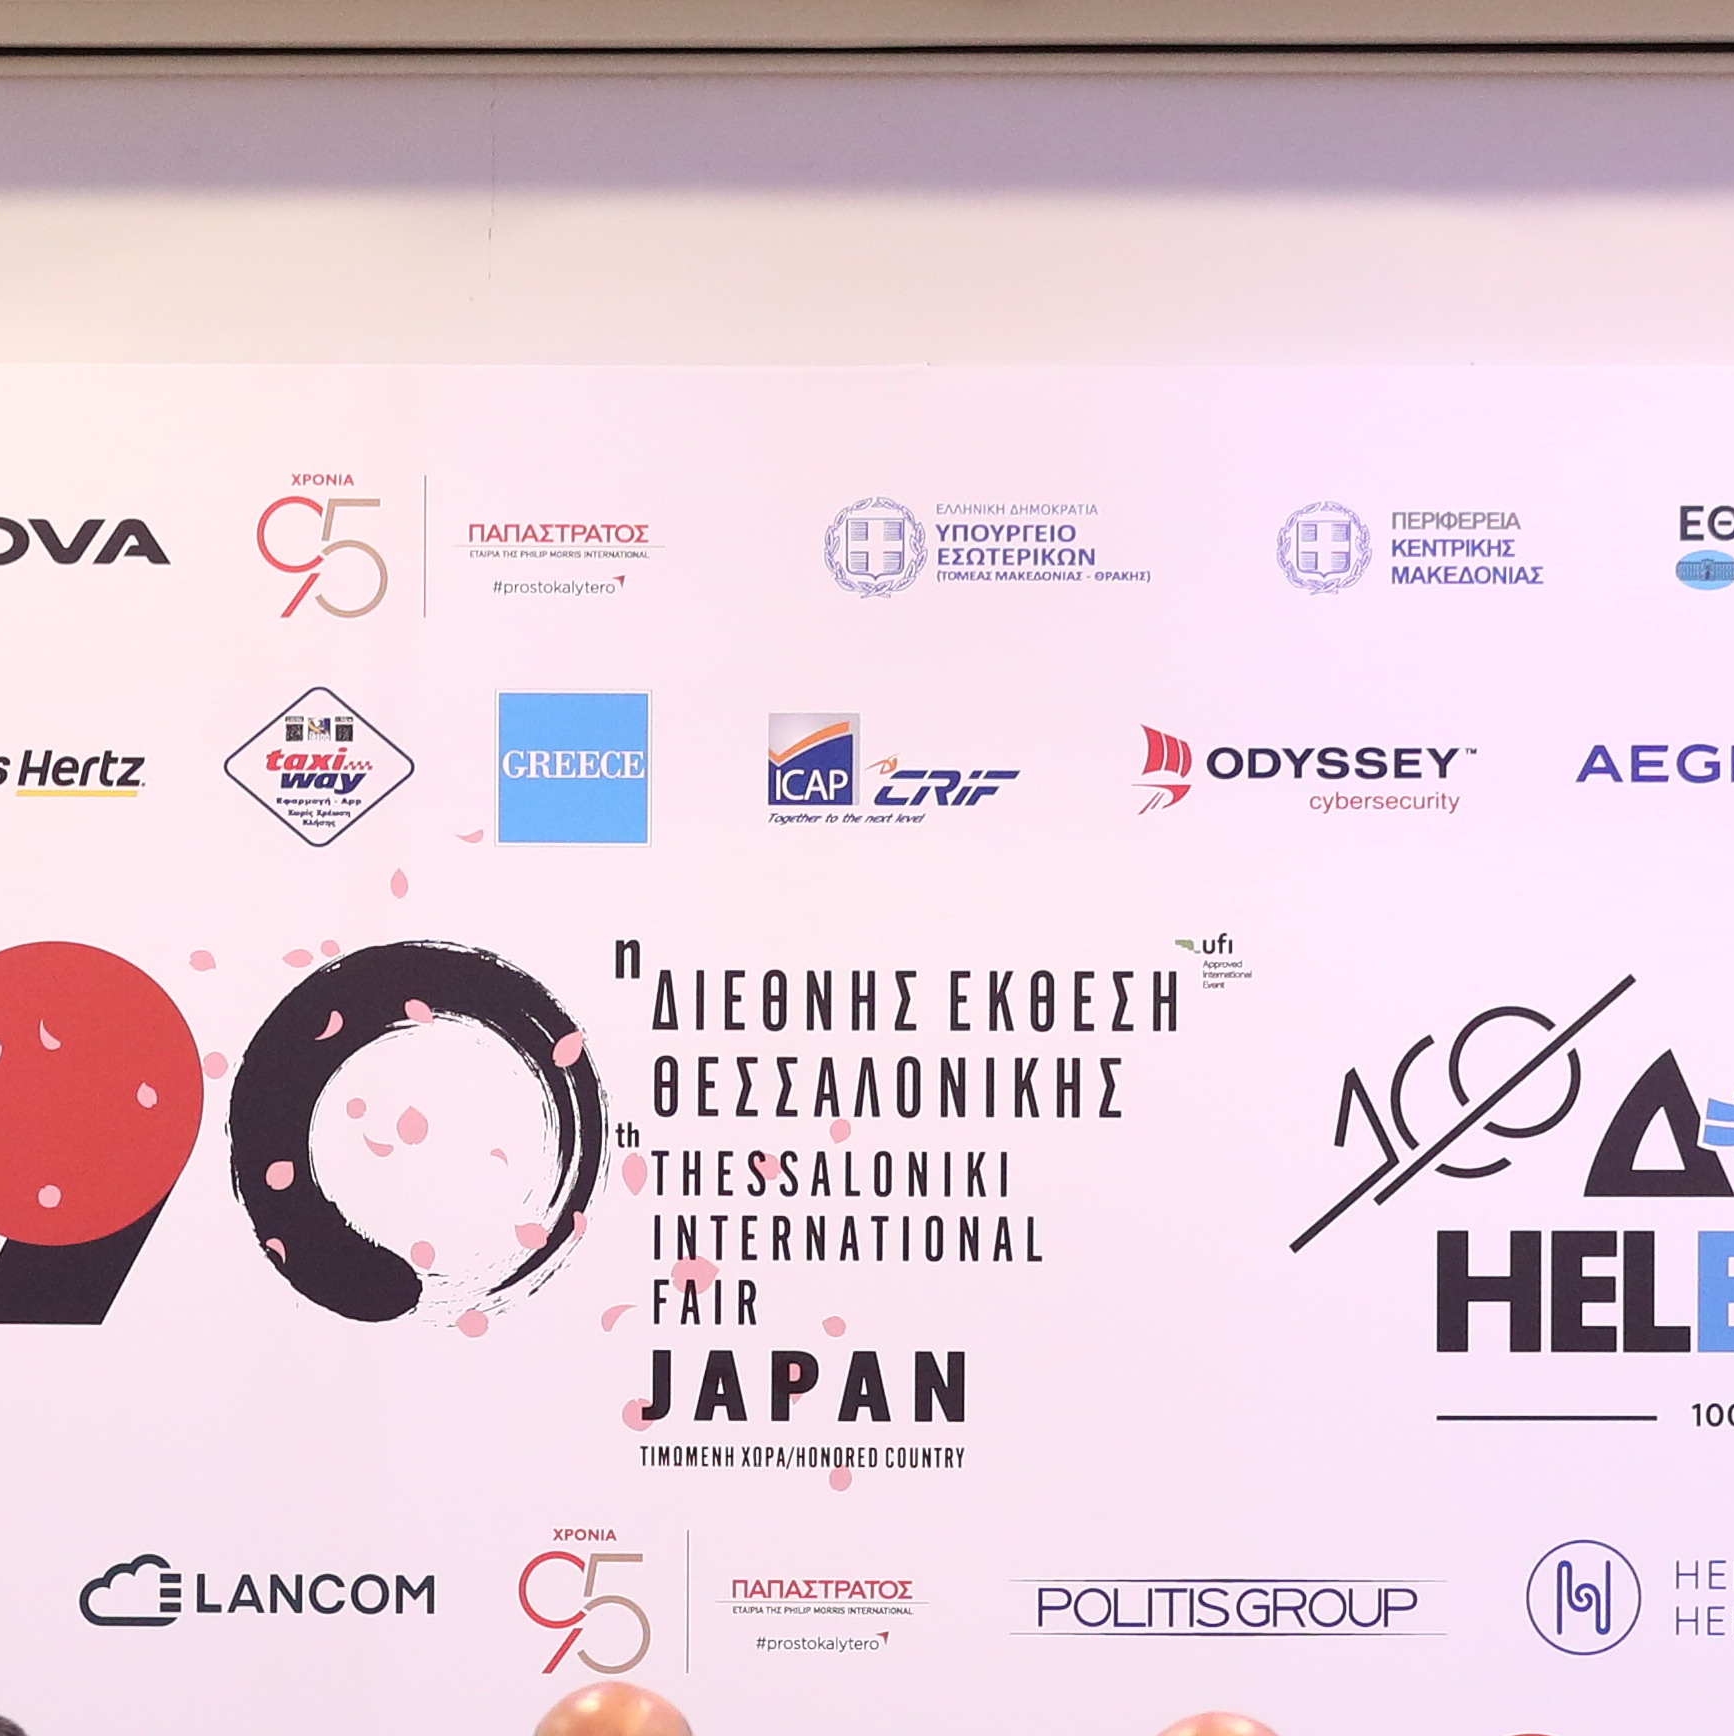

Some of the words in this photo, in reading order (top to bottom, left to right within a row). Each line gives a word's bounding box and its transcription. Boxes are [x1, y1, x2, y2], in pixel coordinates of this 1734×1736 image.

[291, 473, 355, 486] ΧΡΟΝΙΑ
[936, 503, 1005, 515] ΕΛΛΗΝΙΚΗ
[1009, 503, 1099, 516] ΔΗΜΟΚΡΑΤΙΑ
[1391, 511, 1522, 531] ΠΕΡΙΦΕΡΕΙΑ
[468, 523, 649, 544] ΠΑΠΑΣΤΡΑΤΟΣ
[935, 524, 1077, 543] ΥΠΟΥΡΓΕΙΟ
[256, 495, 388, 619] 95
[469, 549, 501, 558] ΕΤΑΙΡΙΑ
[502, 550, 518, 559] ΤΗΣ
[519, 550, 548, 559] PHILIP
[549, 550, 582, 559] MORRIS
[583, 550, 648, 559] INTERNATIONAL
[937, 547, 1096, 567] ΕΣΩΤΕΡΙΚΩΝ
[1391, 538, 1516, 558] ΚΕΝΤΡΙΚΗΣ
[935, 570, 993, 583] (ΤΟΜΕΑΣ
[995, 571, 1083, 582] ΜΑΚΕΔΟΝΙΑΣ
[1094, 570, 1151, 583] ΘΡΑΚΗΣ)
[1391, 565, 1544, 585] ΜΑΚΕΔΟΝΙΑΣ
[492, 579, 616, 597] #prostokalytero
[265, 746, 348, 772] taxi
[501, 748, 647, 782] GREECE
[280, 772, 367, 796] way
[775, 767, 848, 802] ICAP
[1309, 791, 1461, 815] cybersecurity
[768, 812, 822, 826] Together
[824, 813, 839, 824] to
[842, 813, 863, 823] the
[864, 813, 894, 823] next
[895, 813, 926, 823] level
[1202, 959, 1243, 970] Approved
[1202, 970, 1253, 979] International
[1202, 980, 1225, 989] Event
[651, 969, 917, 1032] ΔΙΕΘΝΗΣ
[949, 969, 1177, 1033] ΕΚΘΕΣΗ
[653, 1055, 1122, 1119] ΘΕΣΣΑΛΟΝΙΚΗΣ
[615, 1121, 640, 1149] th
[650, 1149, 1008, 1198] THESSALONIKI
[653, 1214, 1043, 1262] INTERNATIONAL
[653, 1279, 757, 1325] FAIR
[641, 1349, 965, 1423] JAPAN
[639, 1445, 734, 1467] ΤΙΜΩΜΕΝΗ
[885, 1447, 965, 1469] COUNTRY
[552, 1528, 617, 1542] ΧΡΟΝΙΑ
[196, 1573, 435, 1615] LANCOM
[732, 1579, 913, 1600] ΠΑΠΑΣΤΡΑΤΟΣ
[518, 1550, 651, 1675] 95
[1037, 1587, 1418, 1628] POLITISGROUP
[755, 1635, 881, 1654] #prostokalytero
